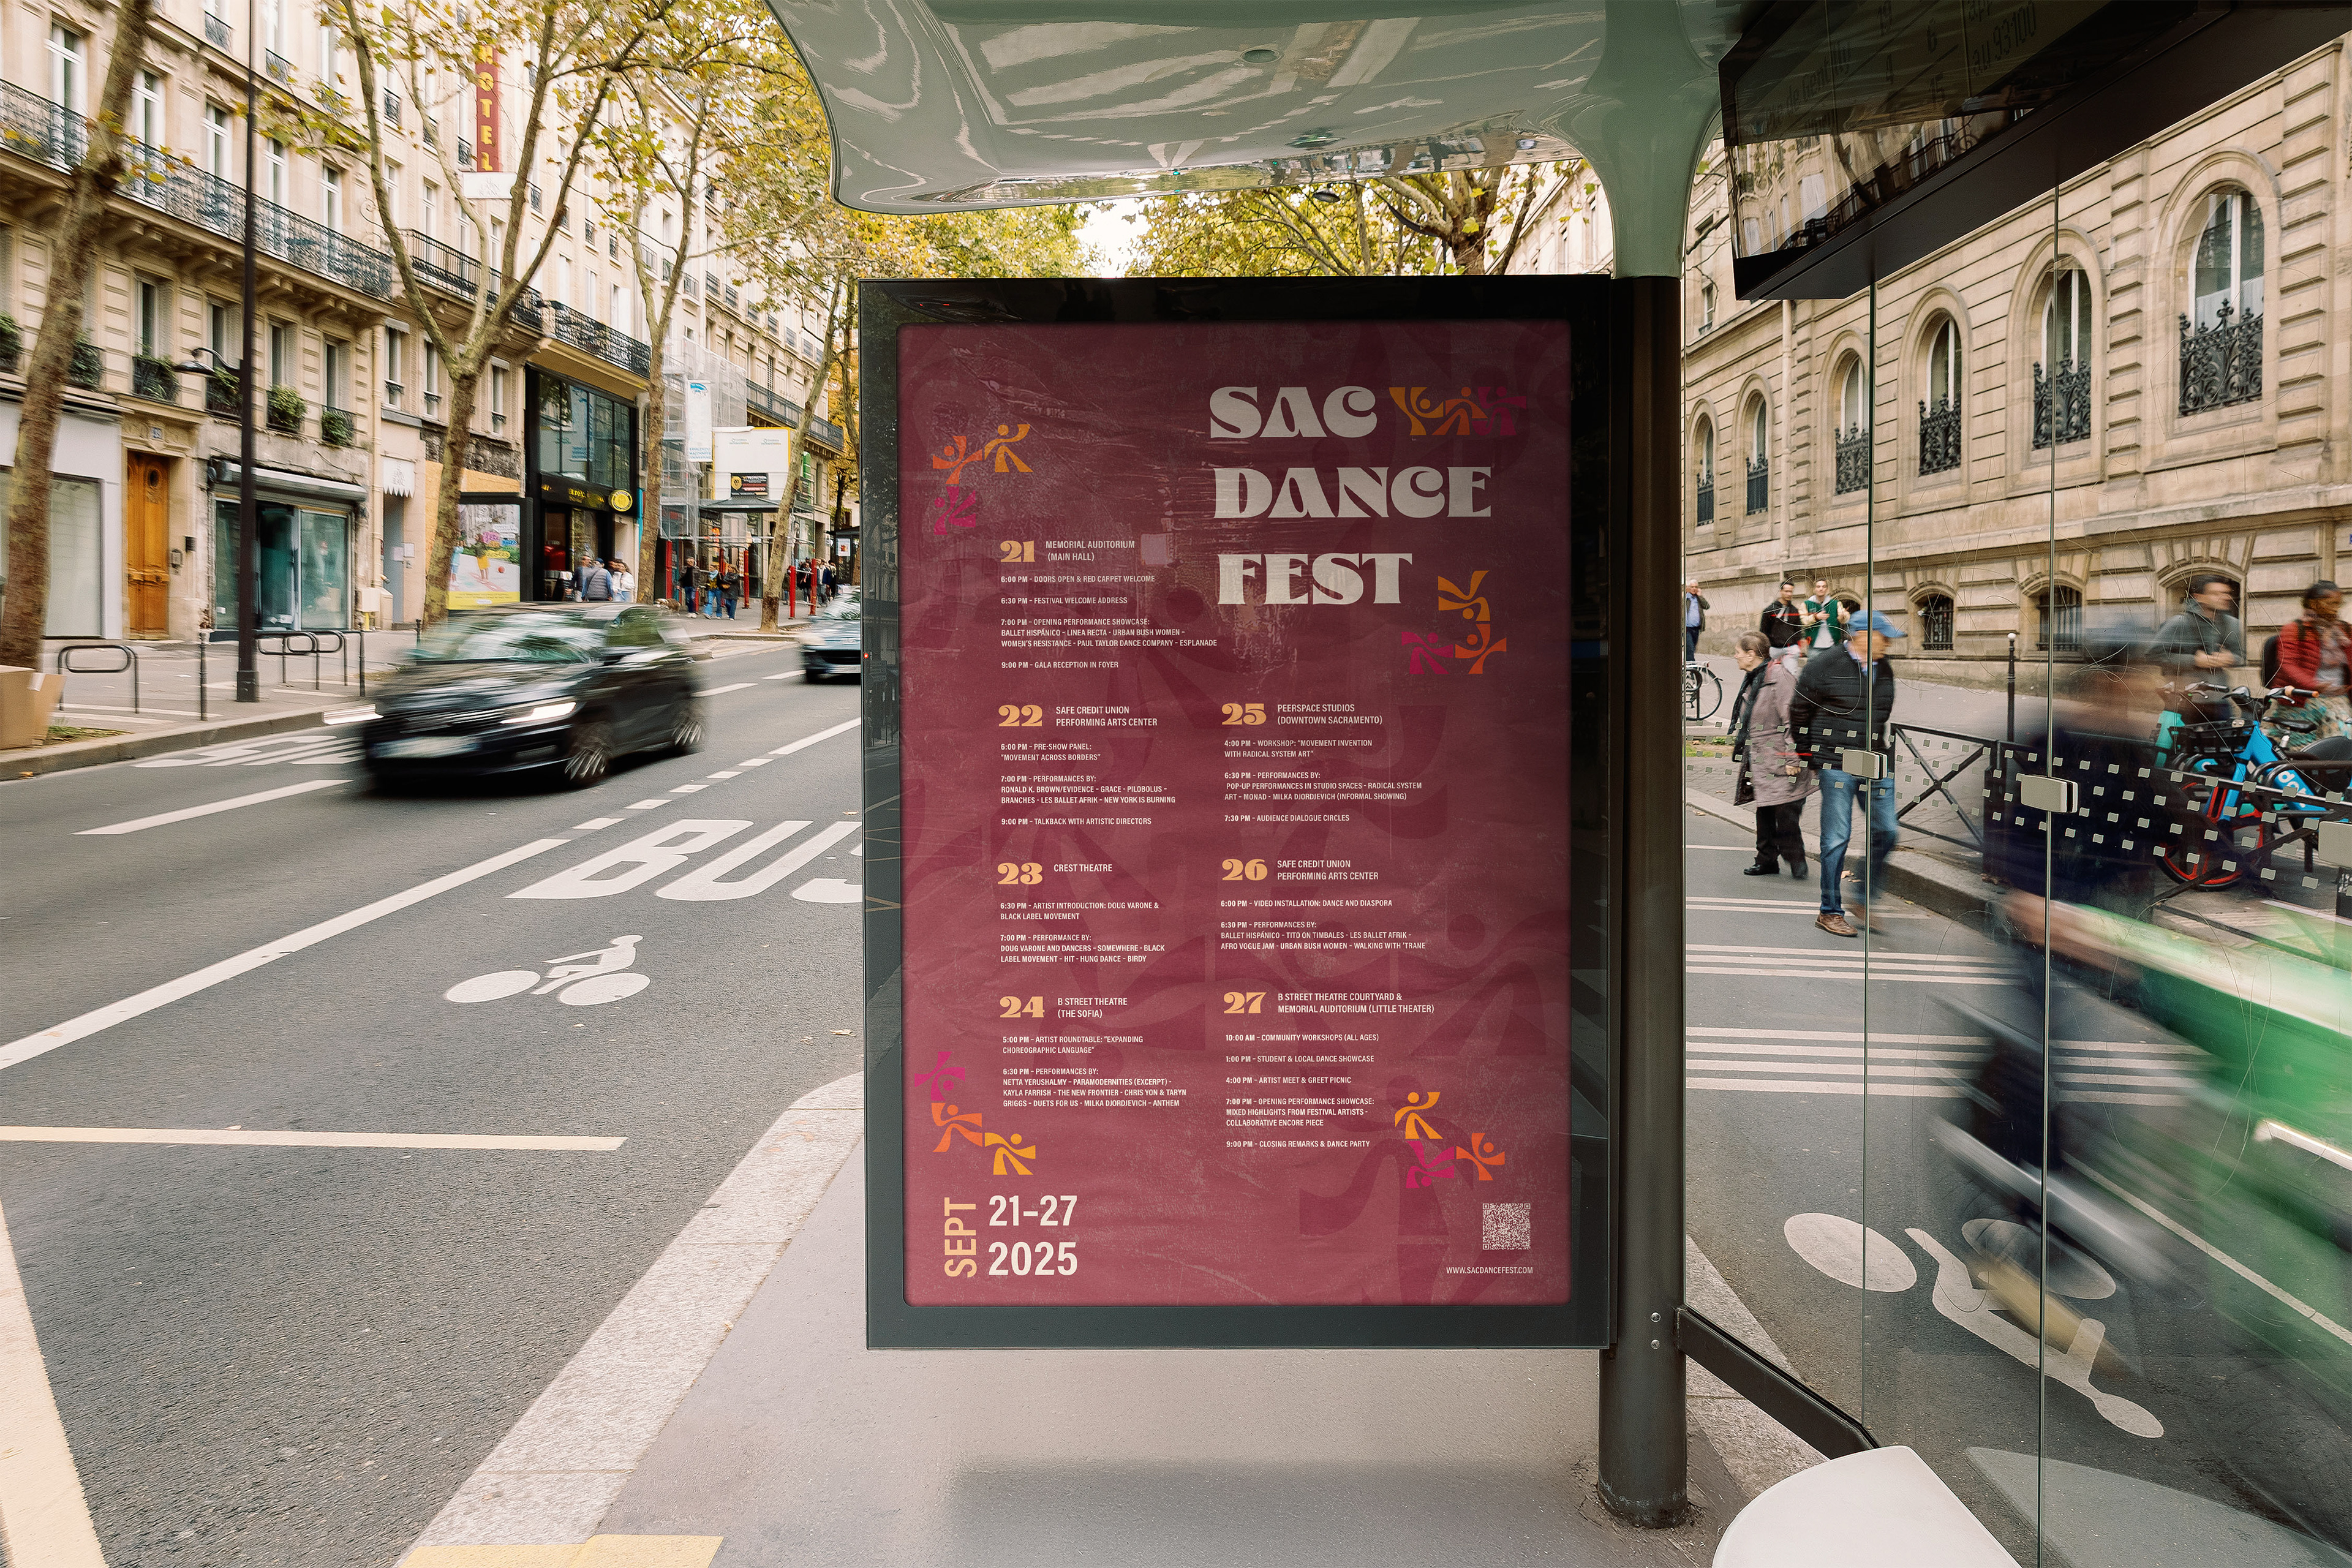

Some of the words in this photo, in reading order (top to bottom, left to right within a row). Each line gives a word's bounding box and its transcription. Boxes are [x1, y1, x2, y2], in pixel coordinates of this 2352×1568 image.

[478, 45, 494, 172] HOTEL
[1209, 385, 1378, 439] SAC
[1213, 465, 1493, 519] DANCE
[1000, 540, 1035, 562] 21
[1048, 552, 1070, 561] (MAIN
[1072, 552, 1095, 561] HALL)
[1217, 552, 1412, 605] FEST
[998, 704, 1042, 727] 22
[1221, 703, 1267, 725] 25
[1278, 716, 1326, 725] (DOWNTOWN
[1328, 715, 1382, 725] SACRAMENTO)
[998, 863, 1043, 885] 23
[1222, 859, 1268, 881] 26
[1000, 996, 1045, 1018] 24
[1058, 1009, 1076, 1019] (THE
[1077, 1009, 1102, 1018] SOFIA)
[1223, 992, 1267, 1014] 27
[1369, 1005, 1396, 1013] (LITTLE
[1398, 1005, 1434, 1013] THEATER)
[944, 1197, 978, 1278] SEPT
[989, 1242, 1077, 1276] 2025
